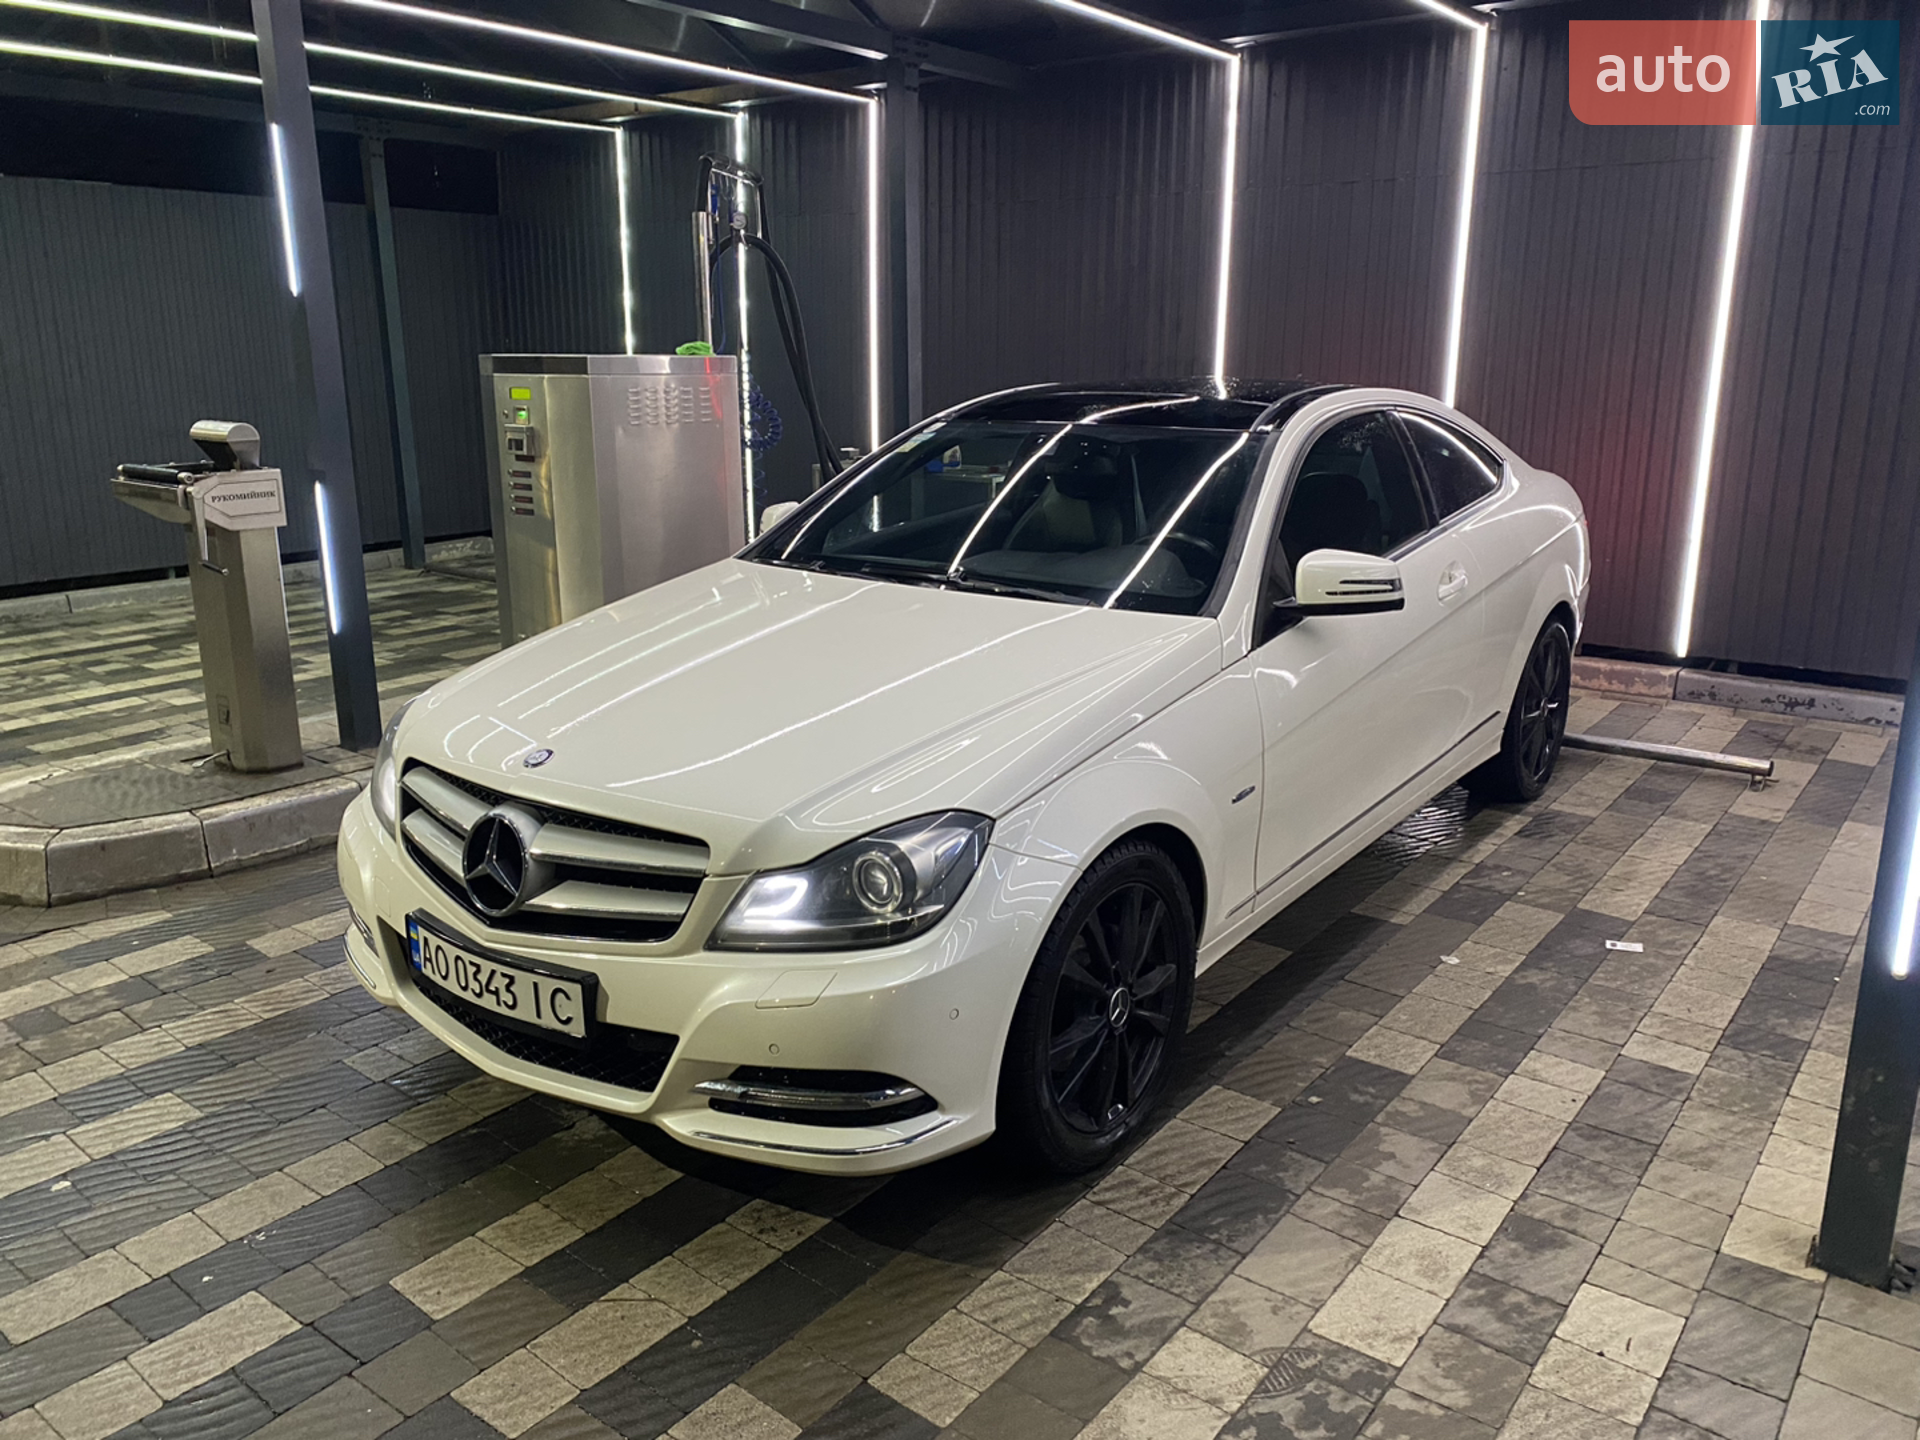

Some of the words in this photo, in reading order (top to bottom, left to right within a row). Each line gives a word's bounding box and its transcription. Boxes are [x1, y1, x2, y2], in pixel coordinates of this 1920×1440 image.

[211, 490, 276, 503] РУКОМИЙНИК
[423, 936, 450, 981] AO
[454, 954, 518, 1011] 0343
[533, 980, 574, 1026] IC
